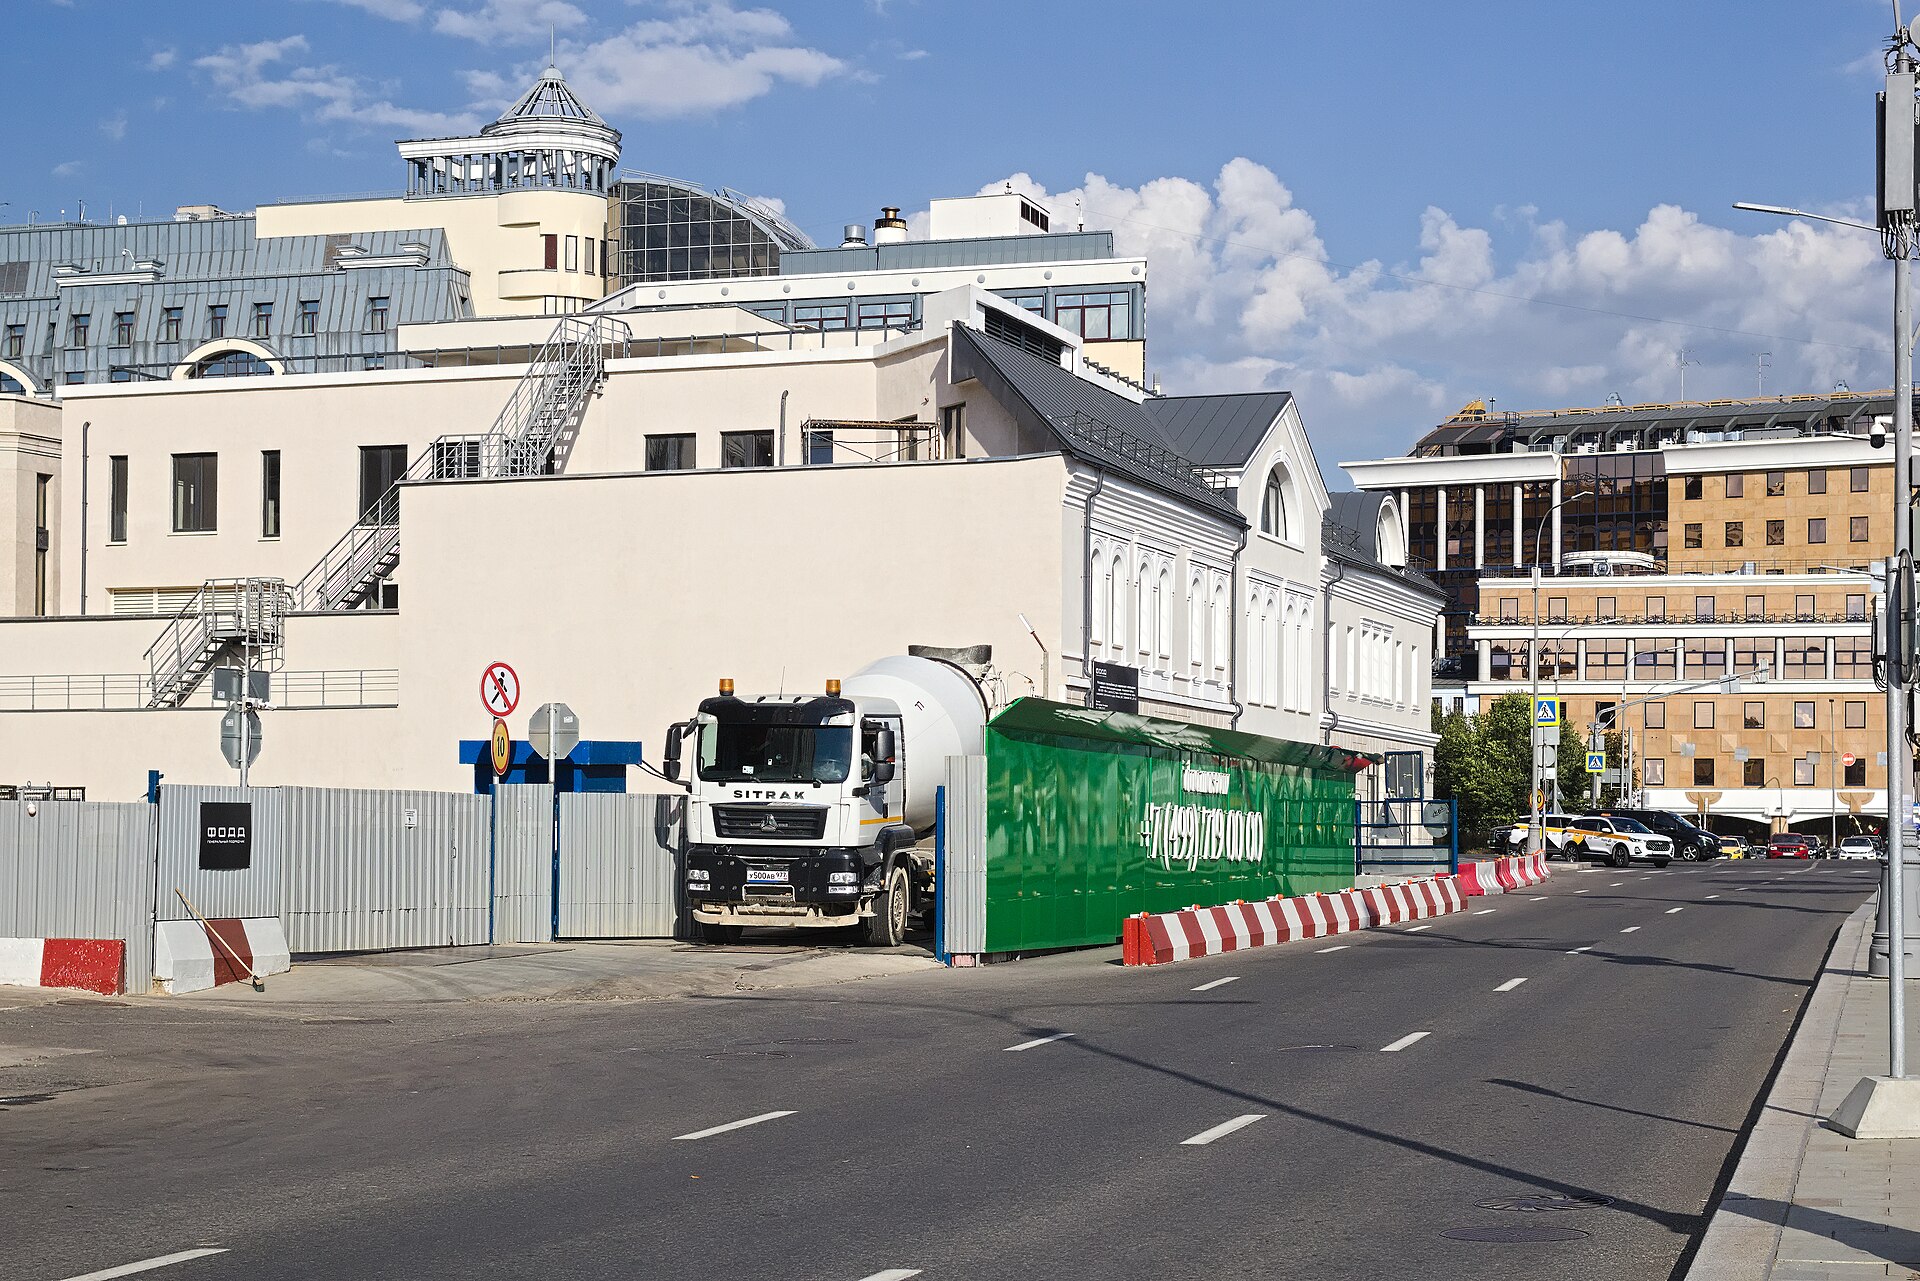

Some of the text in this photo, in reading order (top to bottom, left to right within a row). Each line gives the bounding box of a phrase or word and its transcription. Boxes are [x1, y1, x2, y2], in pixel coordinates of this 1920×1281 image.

[497, 736, 505, 757] 10
[733, 790, 805, 800] SITRAK
[207, 827, 246, 838] ФОДД
[1137, 802, 1161, 859] +7
[1162, 802, 1199, 872] (499)
[1226, 809, 1243, 863] 00
[1245, 811, 1264, 863] 00
